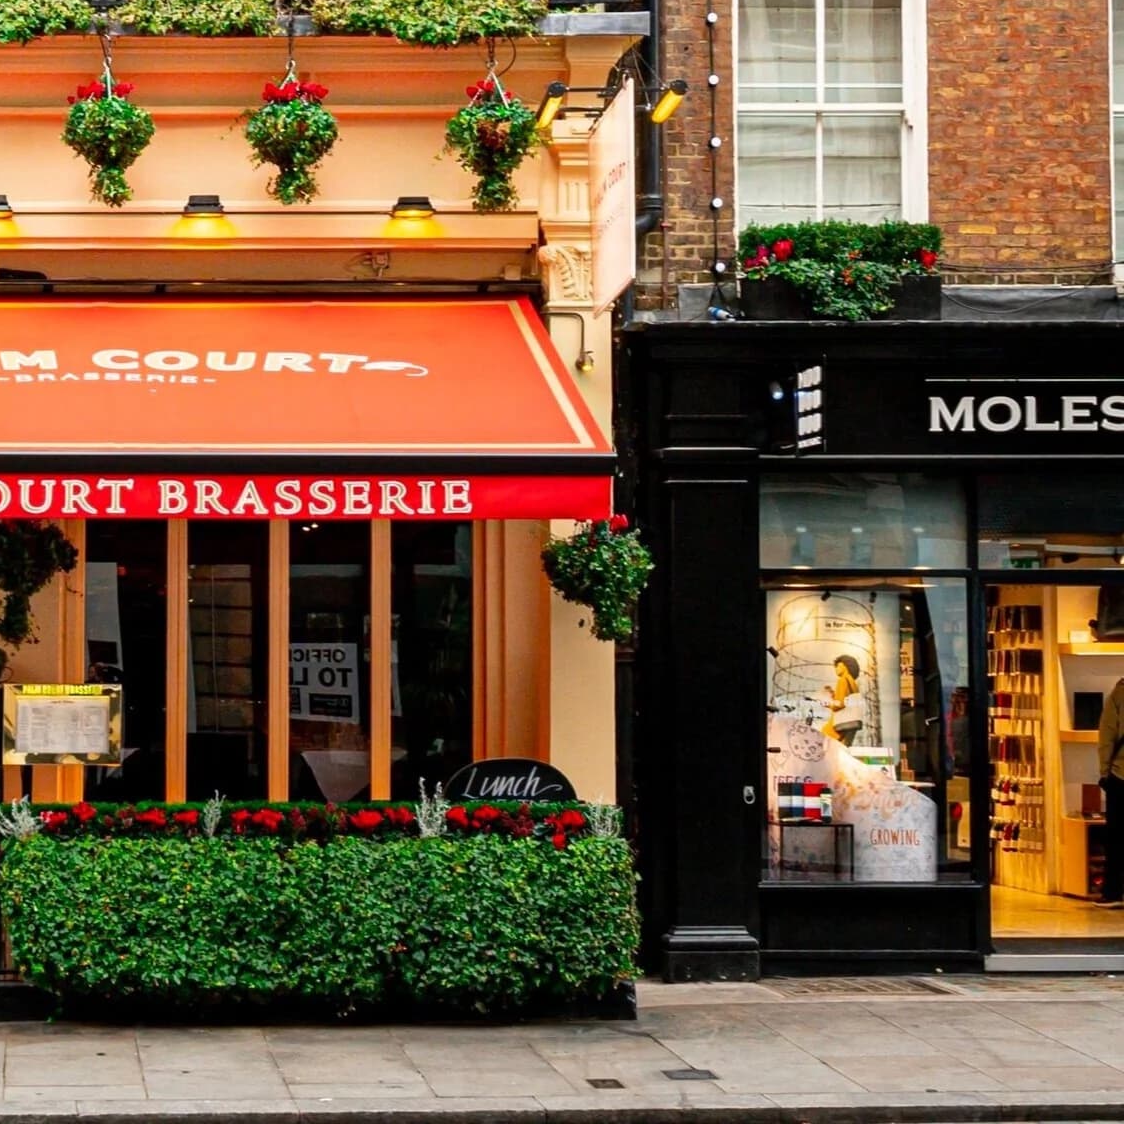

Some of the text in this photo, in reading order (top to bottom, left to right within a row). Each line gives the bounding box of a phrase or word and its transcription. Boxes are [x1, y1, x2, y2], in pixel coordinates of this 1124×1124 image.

[91, 349, 369, 373] COURT
[928, 395, 1124, 432] MOLES
[158, 479, 474, 516] BRASSERIE
[460, 765, 563, 799] Lunch
[869, 828, 921, 846] GROWING
